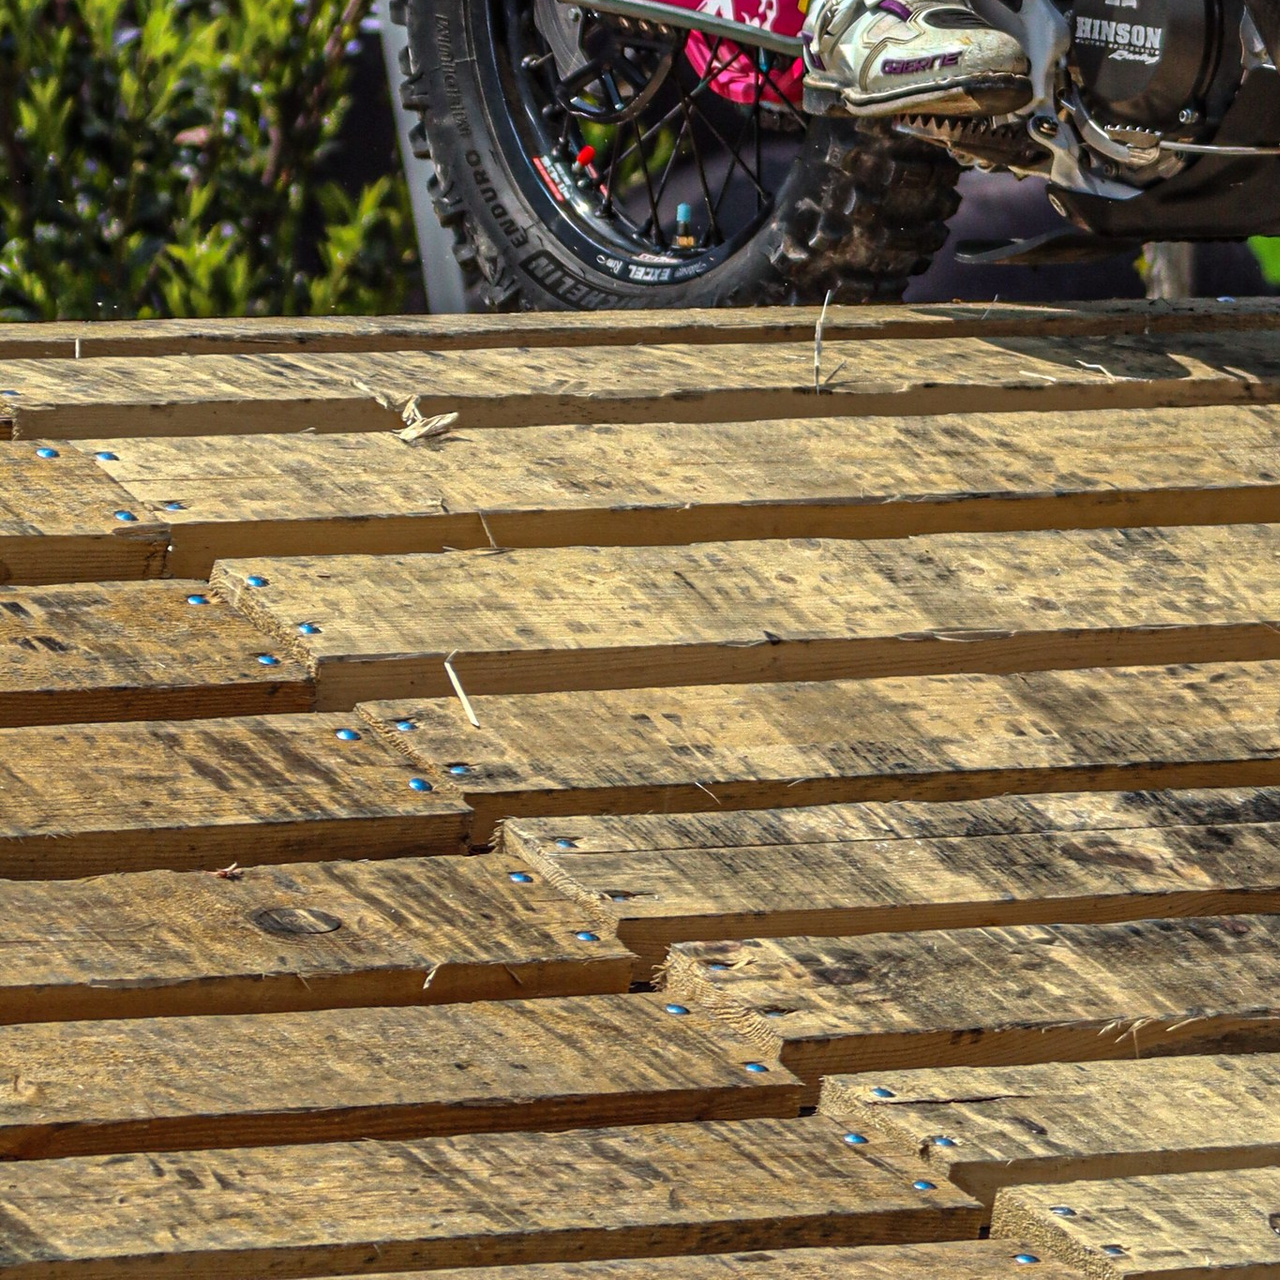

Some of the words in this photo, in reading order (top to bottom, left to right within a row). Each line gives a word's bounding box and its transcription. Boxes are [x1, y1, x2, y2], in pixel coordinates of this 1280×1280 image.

[1074, 15, 1163, 49] HINSON
[464, 148, 529, 249] ENDURO
[627, 263, 675, 281] EXCEL
